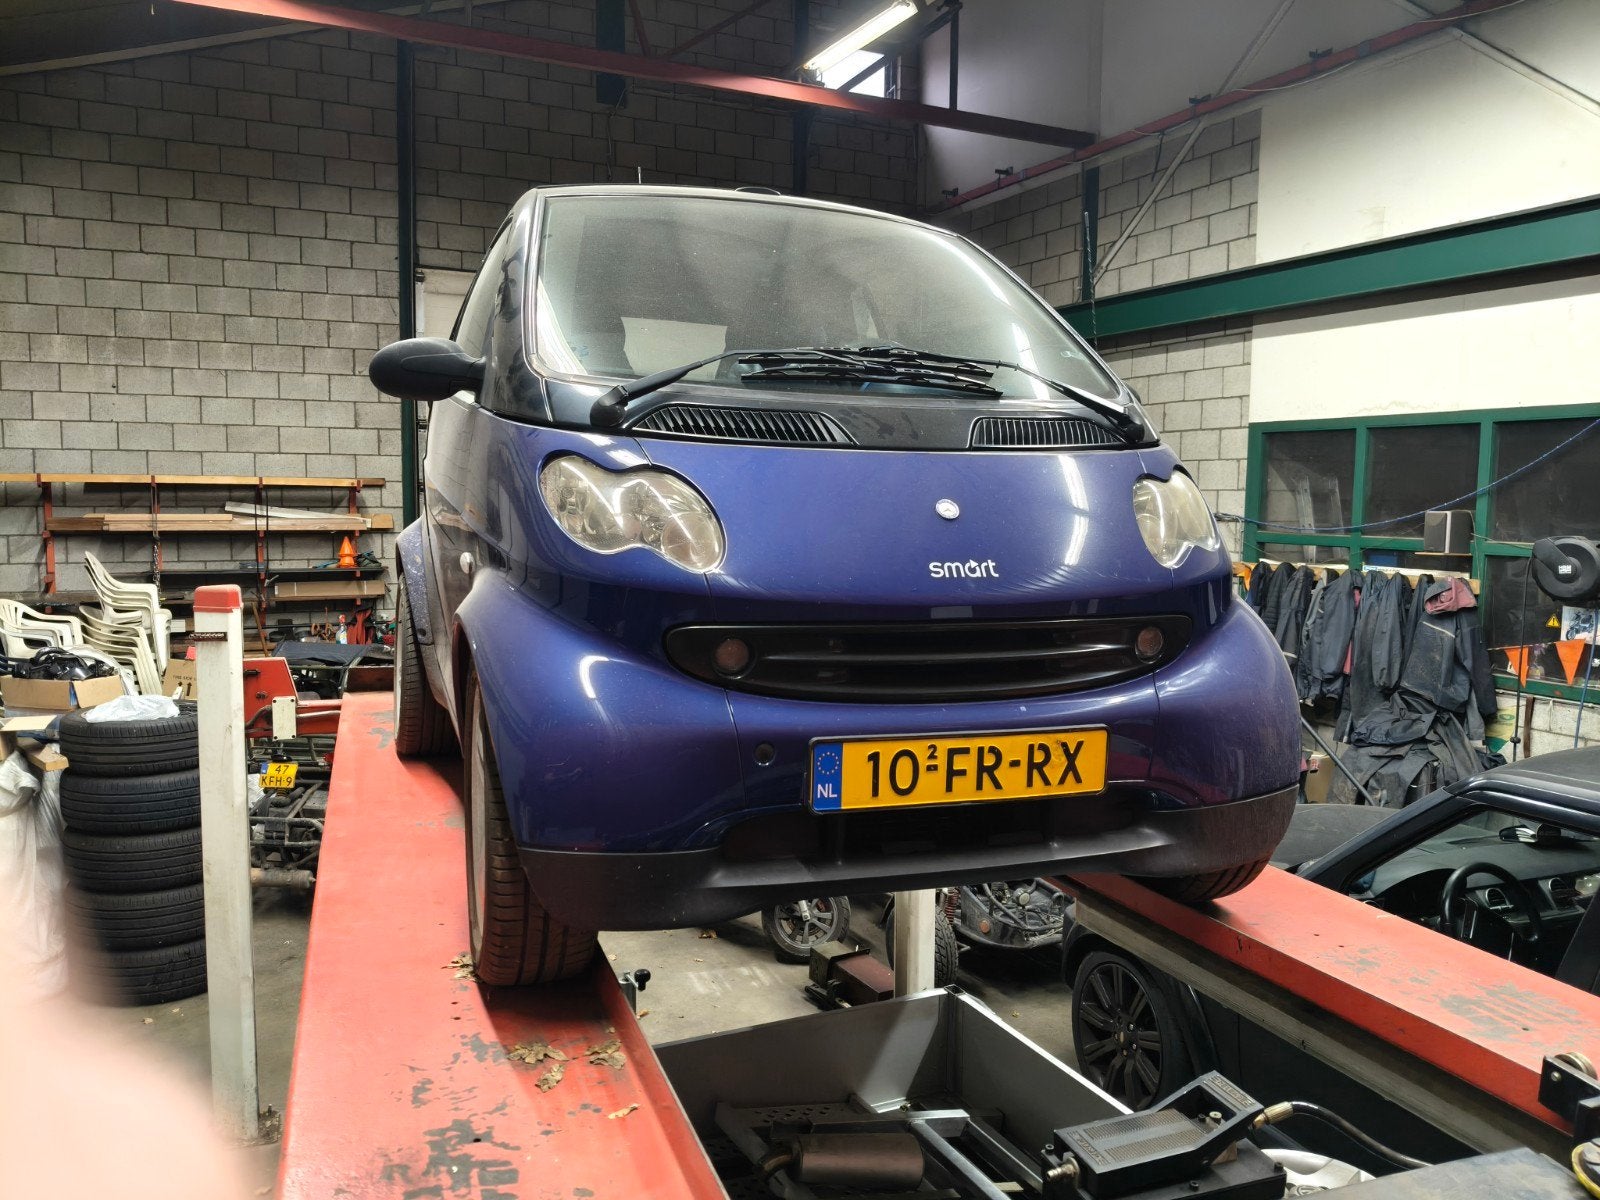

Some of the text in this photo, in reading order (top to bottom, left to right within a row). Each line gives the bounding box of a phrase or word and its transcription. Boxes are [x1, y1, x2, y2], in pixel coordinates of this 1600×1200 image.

[929, 559, 1000, 578] smart
[275, 765, 290, 775] 47
[816, 783, 838, 799] NL
